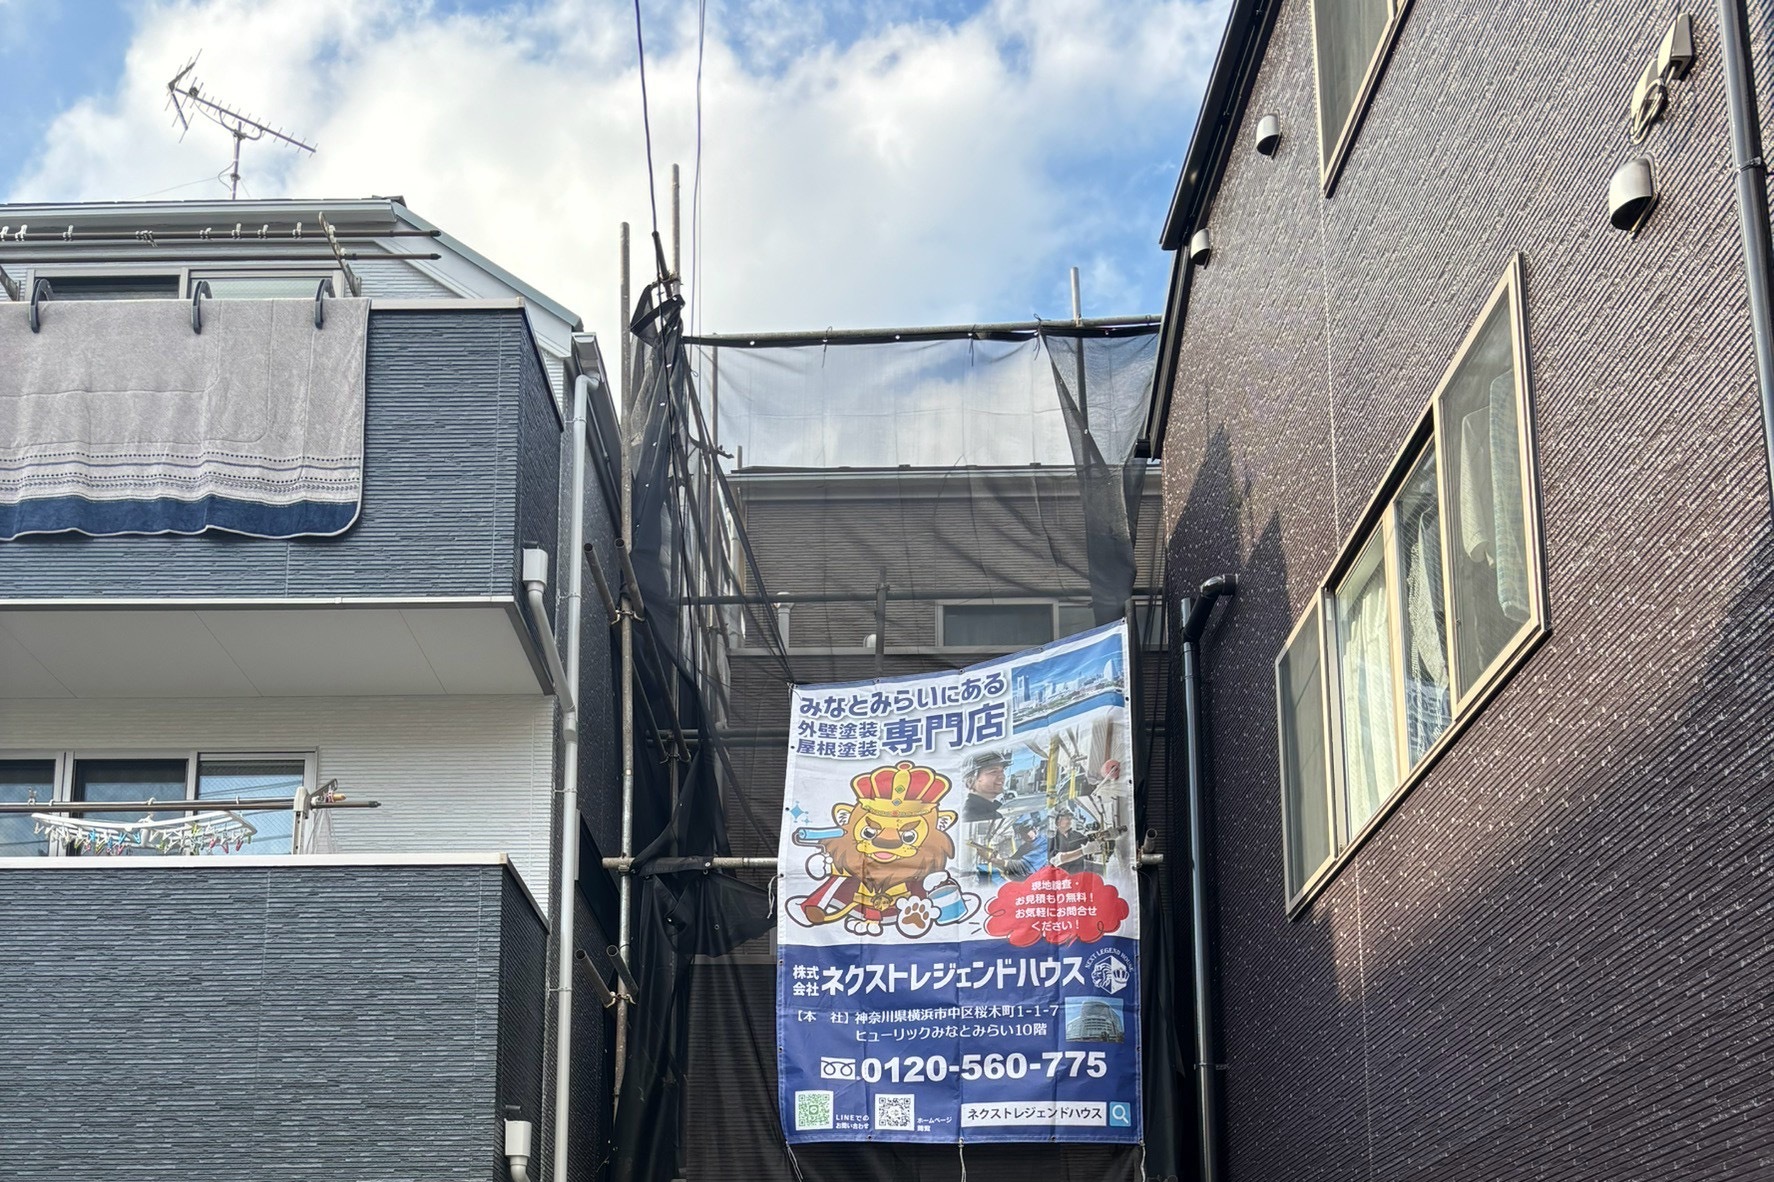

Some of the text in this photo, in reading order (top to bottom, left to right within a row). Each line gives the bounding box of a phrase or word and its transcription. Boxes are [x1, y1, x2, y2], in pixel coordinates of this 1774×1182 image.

[800, 672, 1005, 718] みなとみらいにある
[797, 720, 879, 740] 外壁塗装
[882, 702, 1006, 754] 専門店
[796, 739, 878, 758] 屋根塗装
[1015, 893, 1095, 906] お見積もり無料！
[1015, 906, 1097, 919] お気軽にお問合せ
[1031, 919, 1080, 932] ください！
[792, 964, 820, 980] 株式
[821, 956, 1085, 996] ネクストレジェンドハウス
[792, 982, 820, 997] 会社
[854, 1004, 1060, 1025] 神奈川県横浜市中区桜木町1-1-7
[855, 1023, 1048, 1042] ヒューリックみなとみらい10階
[860, 1051, 1108, 1083] 0120-560-775
[835, 1114, 870, 1122] LINEでの
[966, 1105, 1103, 1121] ネクストレジェンドハウス
